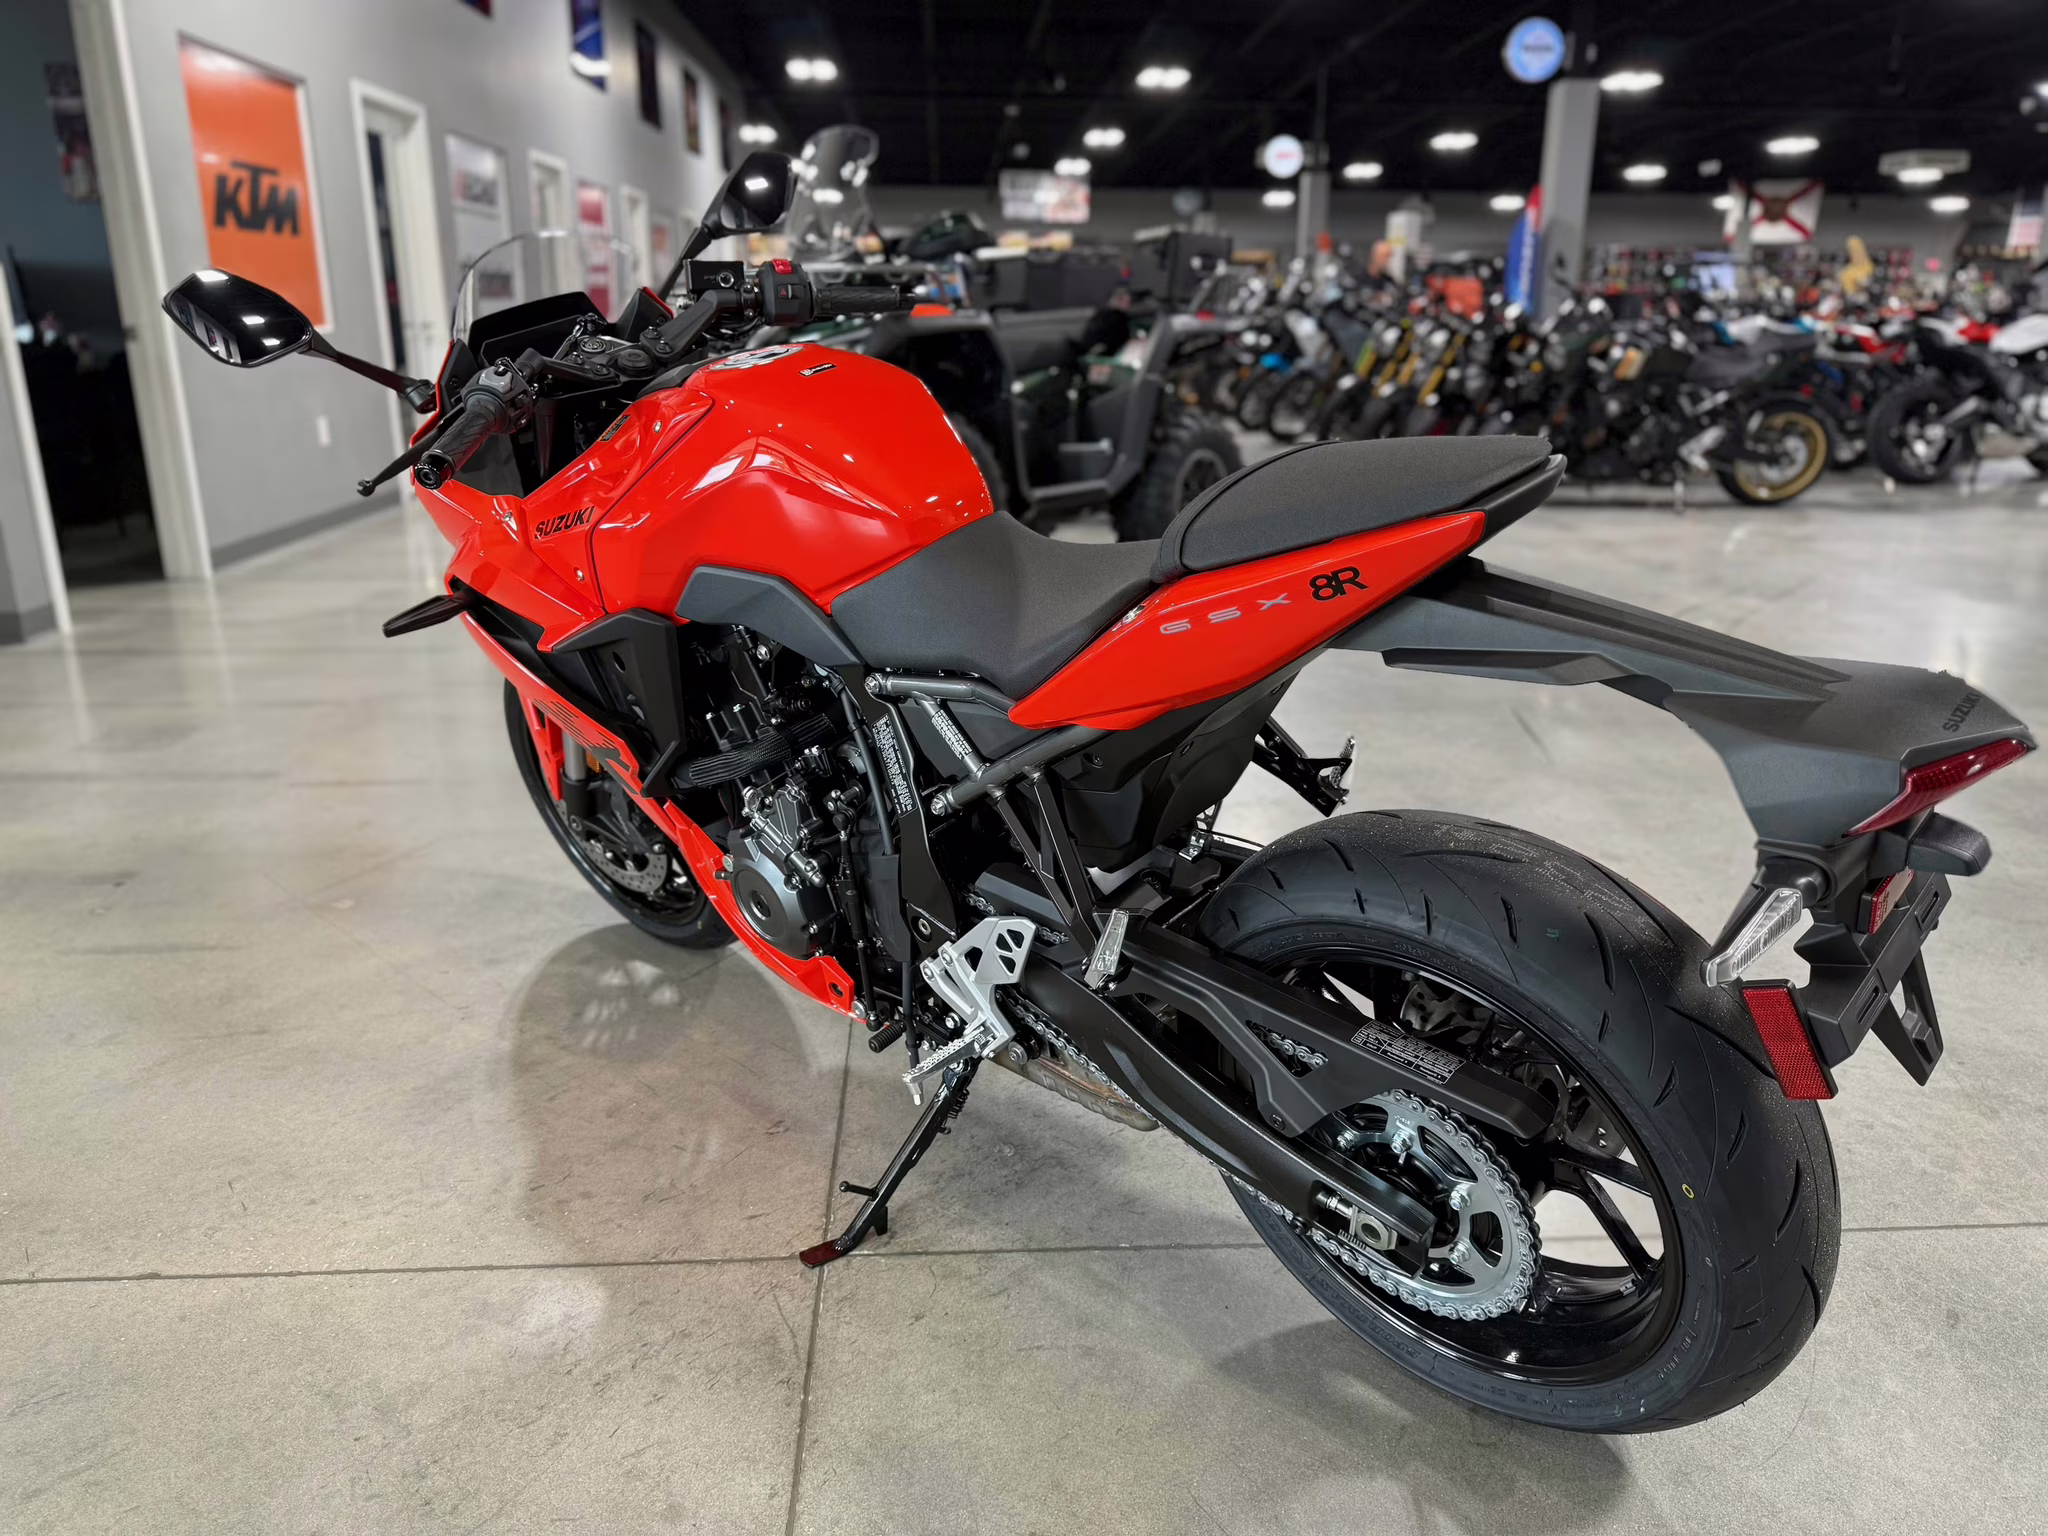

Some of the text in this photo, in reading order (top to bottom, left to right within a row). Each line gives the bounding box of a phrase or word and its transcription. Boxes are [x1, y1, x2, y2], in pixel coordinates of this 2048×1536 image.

[215, 160, 299, 236] KTM
[534, 506, 595, 540] SUZUKI
[1309, 565, 1369, 602] 8R
[1942, 692, 1982, 732] SUZUKI
